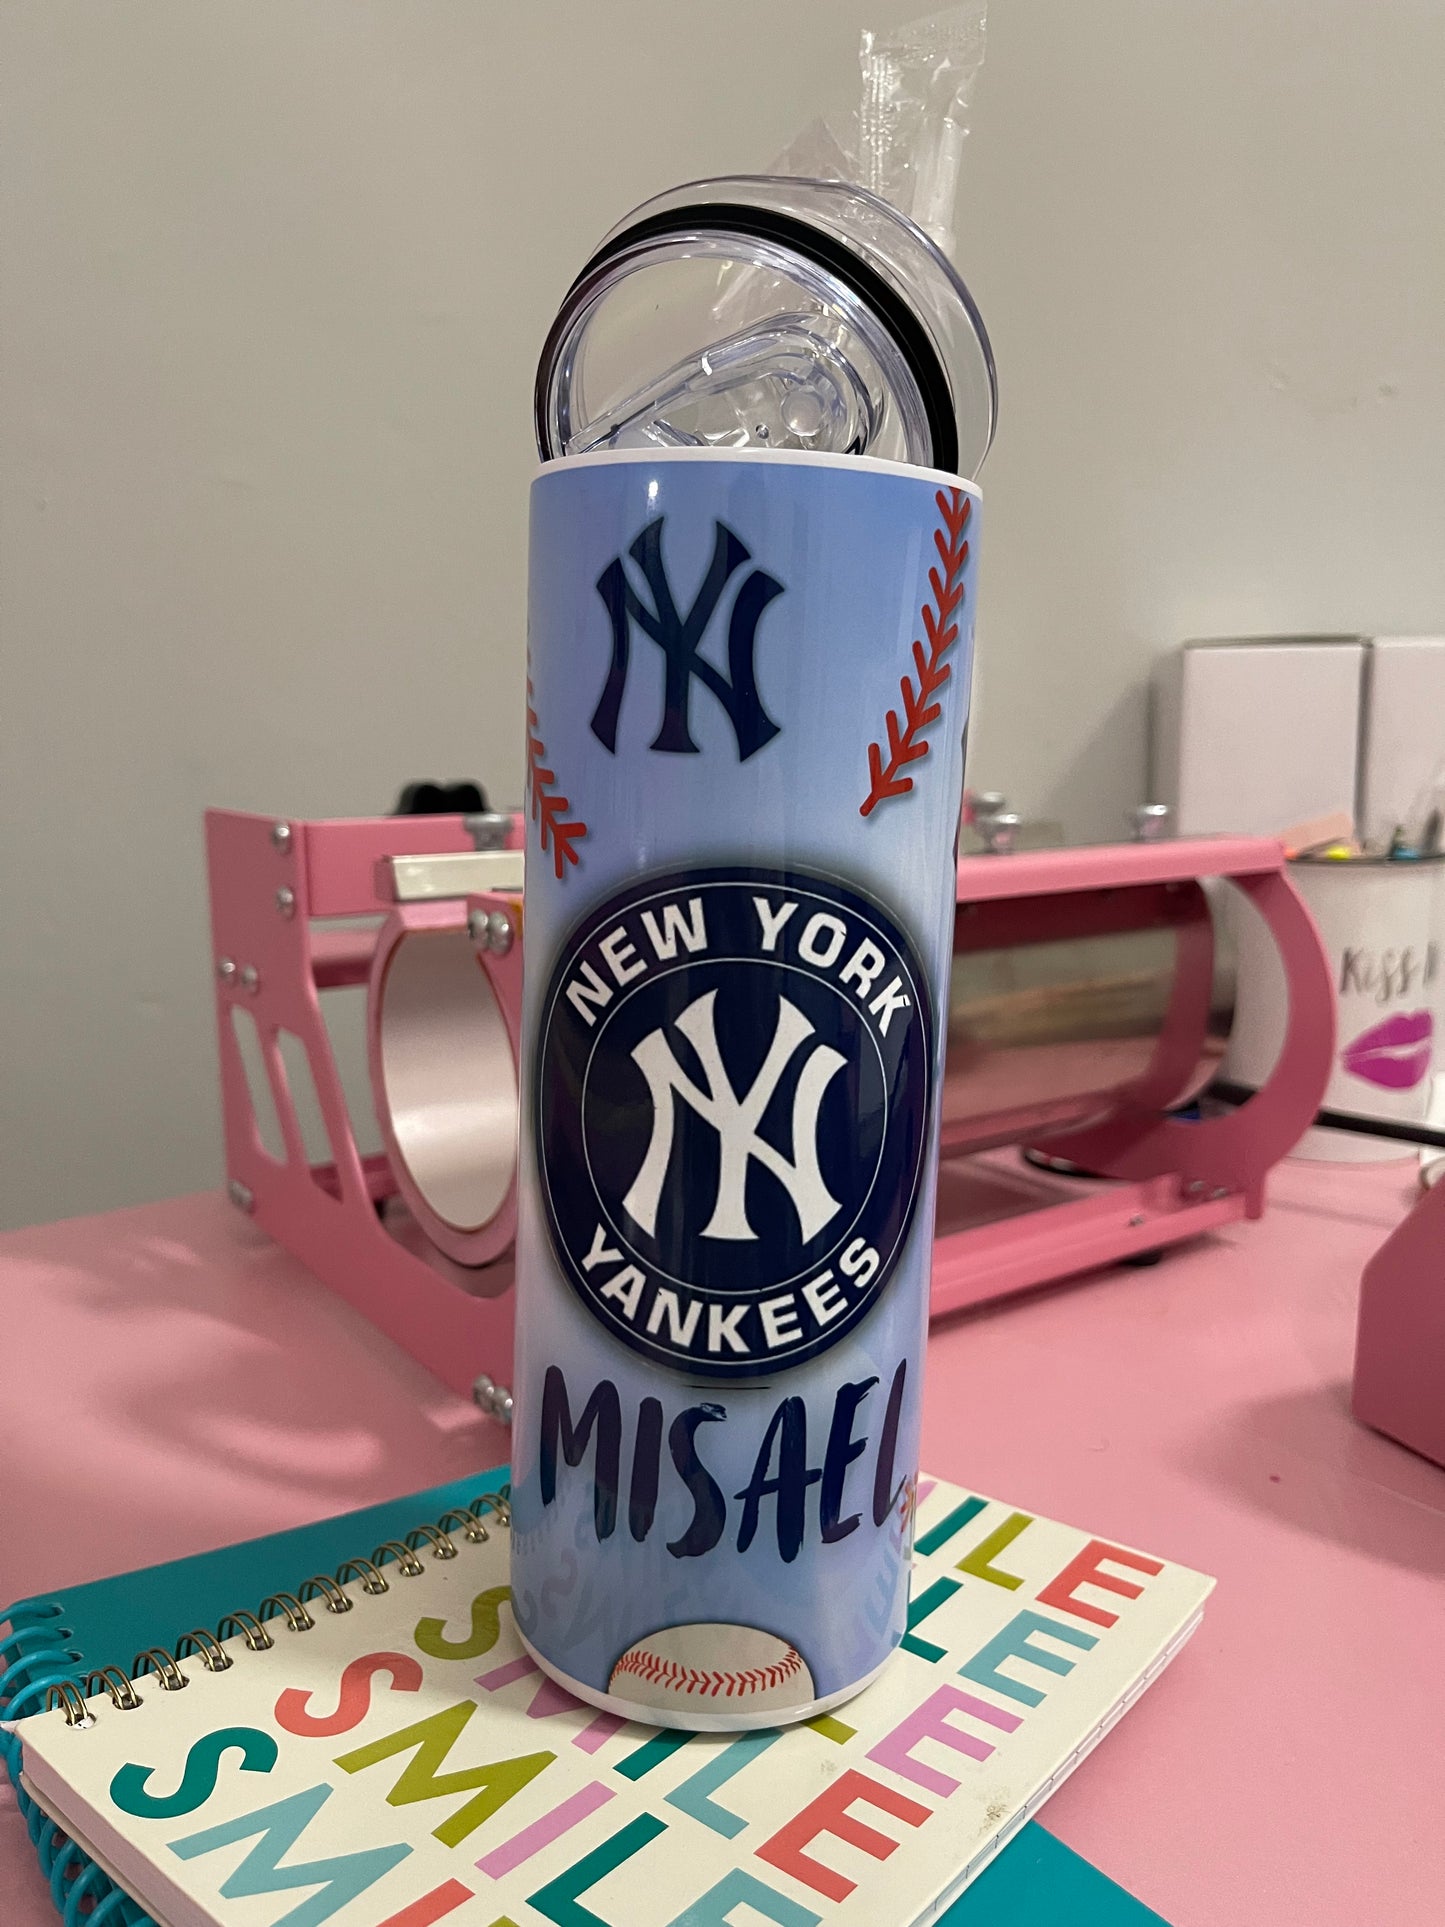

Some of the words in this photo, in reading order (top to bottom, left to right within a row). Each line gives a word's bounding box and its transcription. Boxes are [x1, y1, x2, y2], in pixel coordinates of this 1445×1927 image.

[590, 516, 786, 763] NY
[565, 896, 708, 1027] NEW
[752, 896, 912, 1038] YORK
[621, 988, 849, 1246] NY
[581, 1223, 880, 1353] YANKEES
[540, 1358, 907, 1564] MISAEL
